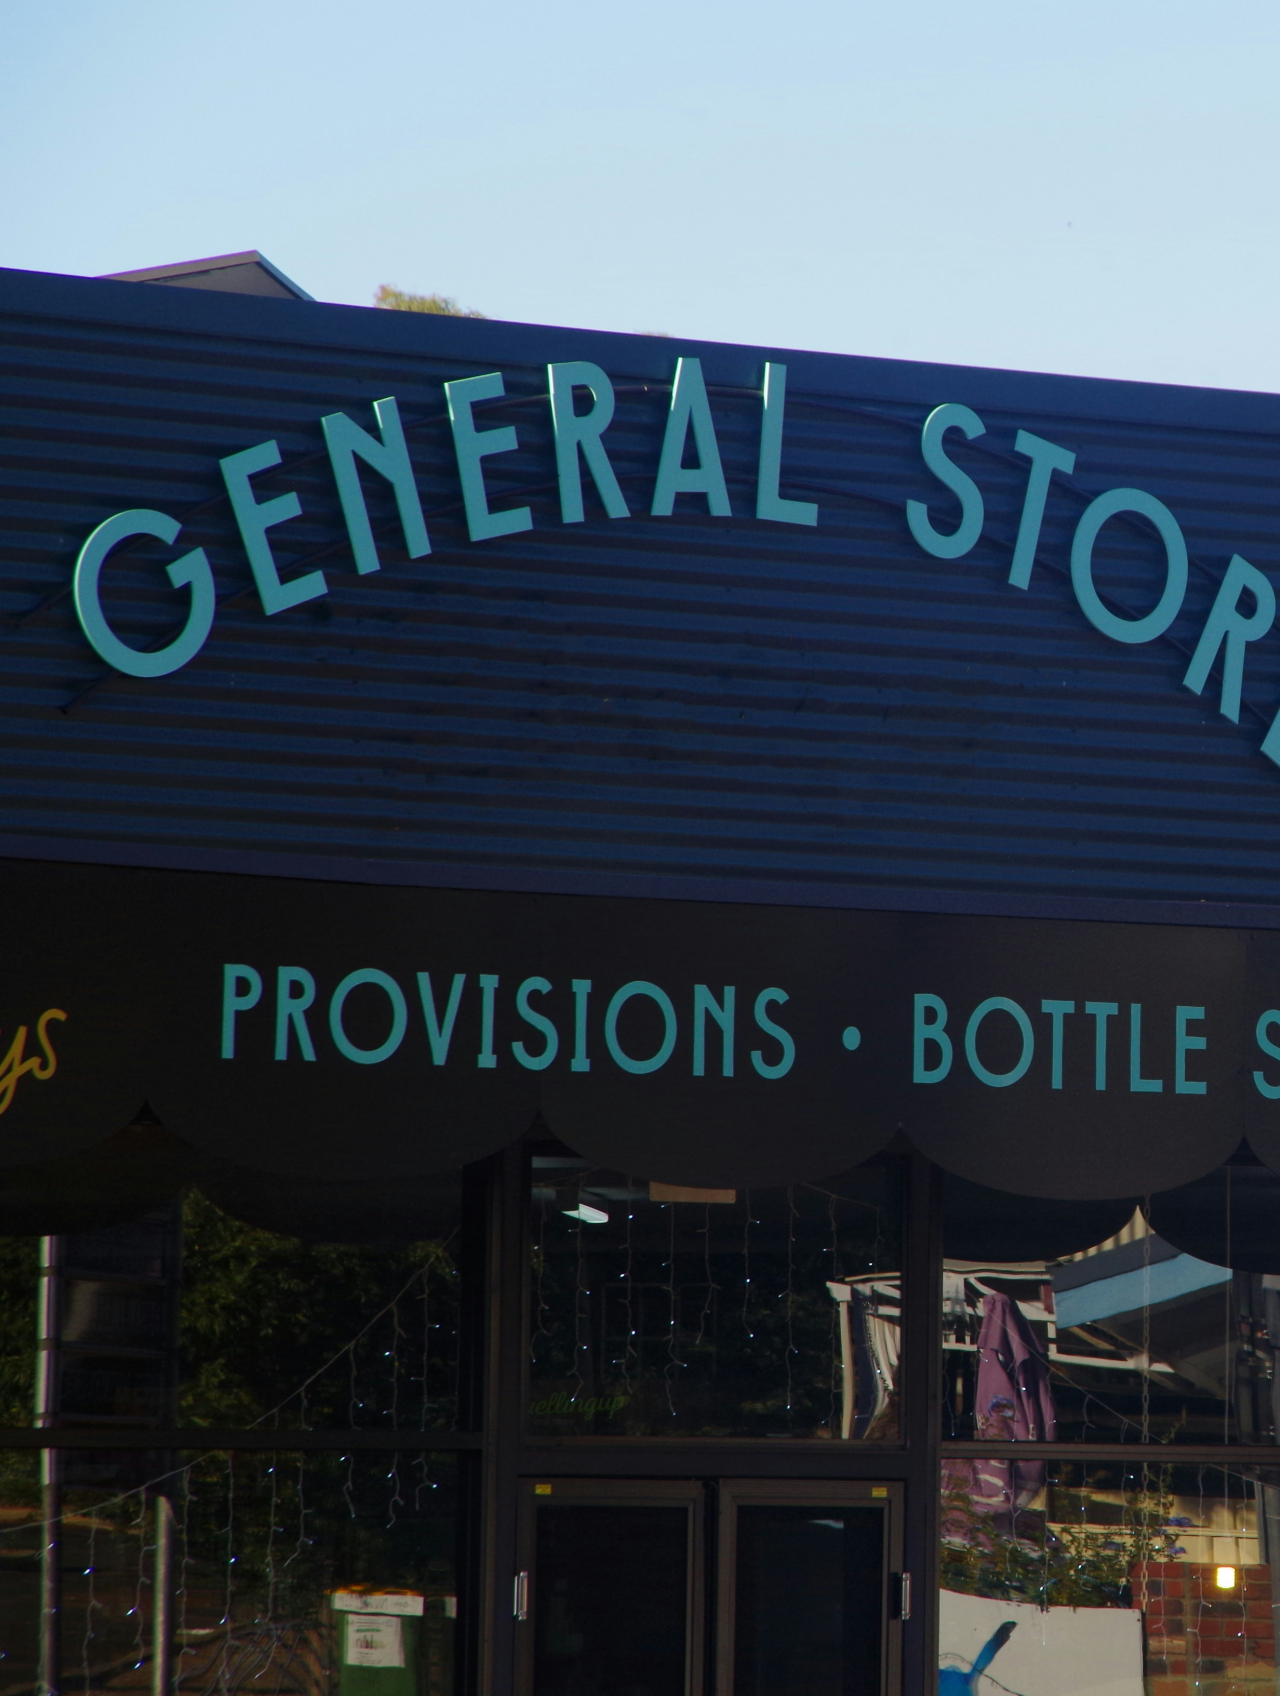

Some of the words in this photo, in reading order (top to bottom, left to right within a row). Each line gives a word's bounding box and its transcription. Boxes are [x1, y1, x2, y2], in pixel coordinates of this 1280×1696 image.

[72, 356, 819, 678] GENERAL
[0, 1008, 68, 1115] ys
[220, 963, 796, 1080] PROVISIONS
[912, 993, 1207, 1095] BOTTLE
